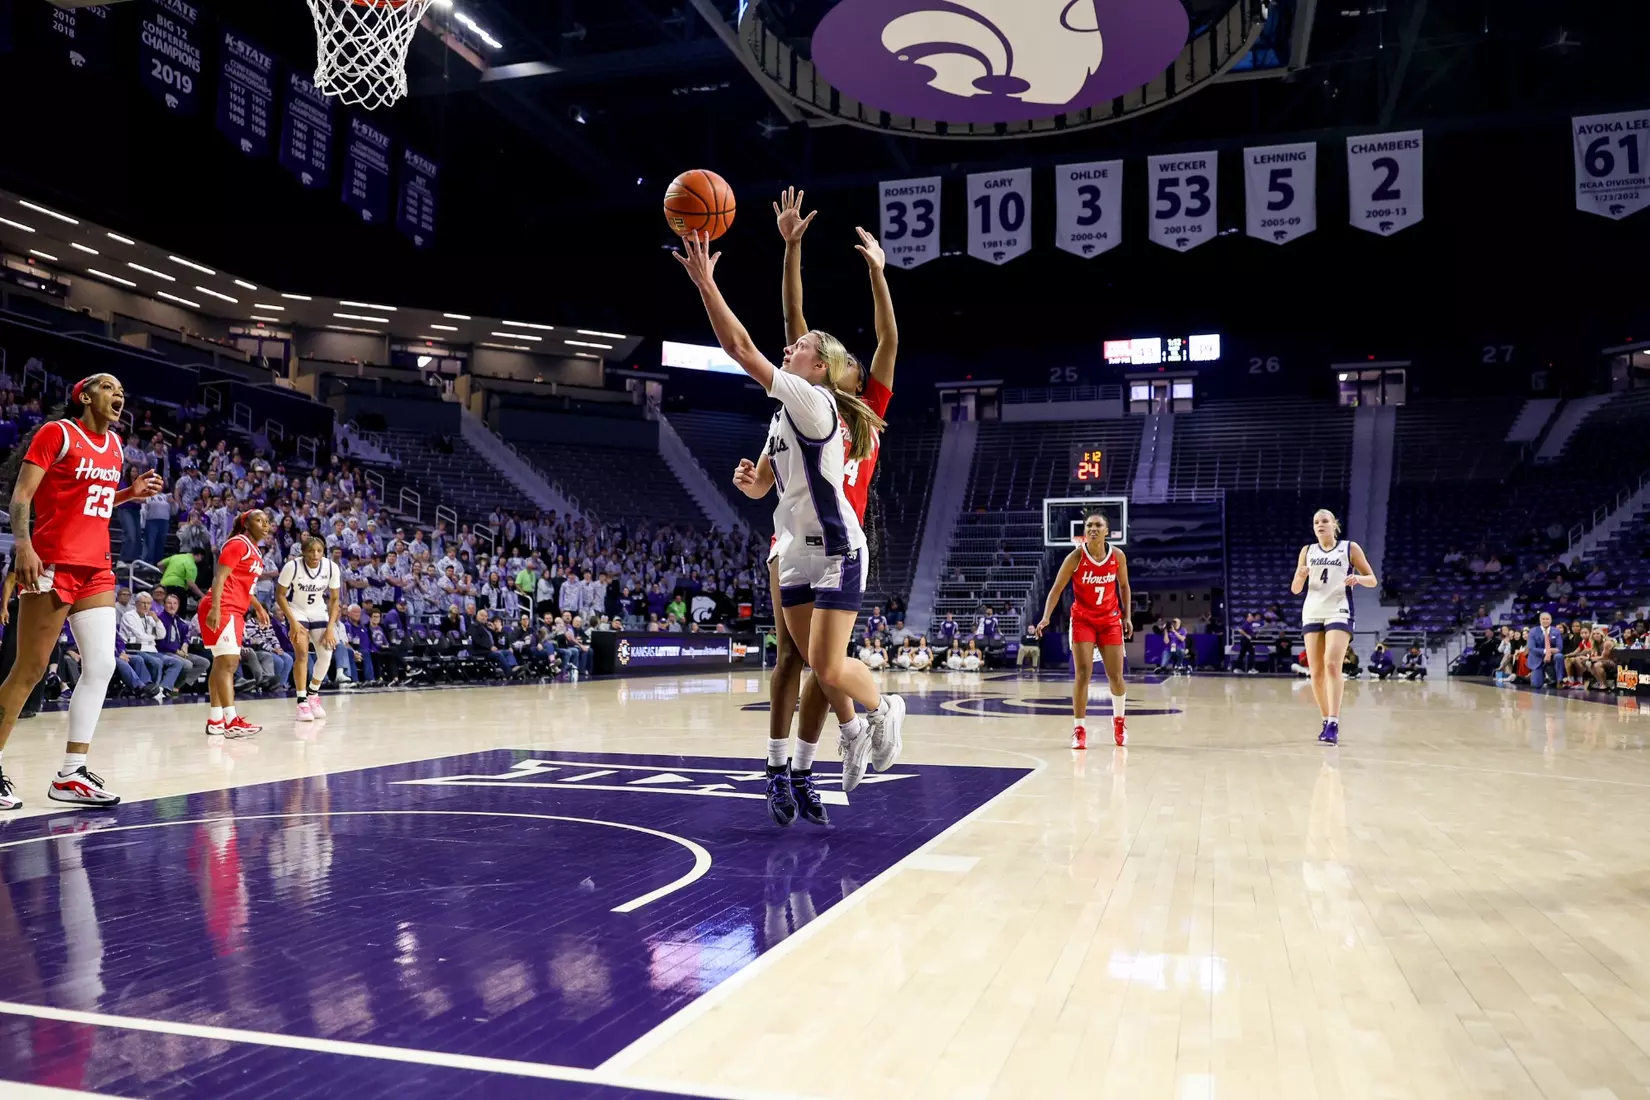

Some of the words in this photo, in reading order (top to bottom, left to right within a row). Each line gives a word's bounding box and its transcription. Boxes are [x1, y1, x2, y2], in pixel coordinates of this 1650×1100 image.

[52, 8, 76, 26] 2010
[52, 20, 75, 38] 2018
[156, 13, 174, 31] BIG
[176, 26, 188, 40] 12
[142, 20, 200, 59] CONFERENCE
[141, 30, 200, 73] CHAMPIONS
[224, 32, 272, 69] K-STATE
[151, 58, 193, 94] 2019
[351, 117, 390, 148] K-STATE
[1578, 122, 1623, 134] AYOKA
[1626, 119, 1650, 130] LEE
[1351, 140, 1420, 154] CHAMBERS
[1585, 134, 1639, 177] 61
[1159, 160, 1206, 172] WECKER
[1253, 151, 1306, 164] LEHNING
[984, 178, 1013, 189] GARY
[1070, 169, 1108, 181] OHLDE
[1371, 156, 1401, 202] 2
[1580, 181, 1604, 189] NCAA
[1606, 177, 1646, 187] DIVISION
[884, 184, 935, 198] ROMSTAD
[1155, 175, 1211, 220] 53
[1267, 168, 1295, 212] 5
[1594, 192, 1640, 201] 1/23/2022
[973, 191, 1025, 234] 10
[1075, 184, 1102, 226] 3
[1365, 207, 1407, 218] 2009-13
[884, 199, 935, 240] 33
[1260, 217, 1301, 227] 2005-09
[1070, 232, 1108, 242] 2000-04
[1164, 224, 1203, 235] 2001-05
[892, 245, 926, 254] 1979-82
[982, 239, 1017, 249] 1981-83
[1481, 344, 1515, 364] 27
[1049, 365, 1079, 383] 25
[1248, 355, 1280, 375] 26
[1084, 451, 1101, 462] 1:12
[1078, 462, 1099, 480] 24
[83, 484, 116, 519] 23
[1310, 557, 1342, 566] Wildcats
[1320, 568, 1328, 584] 4
[307, 594, 316, 605] 5
[1094, 586, 1106, 606] 7
